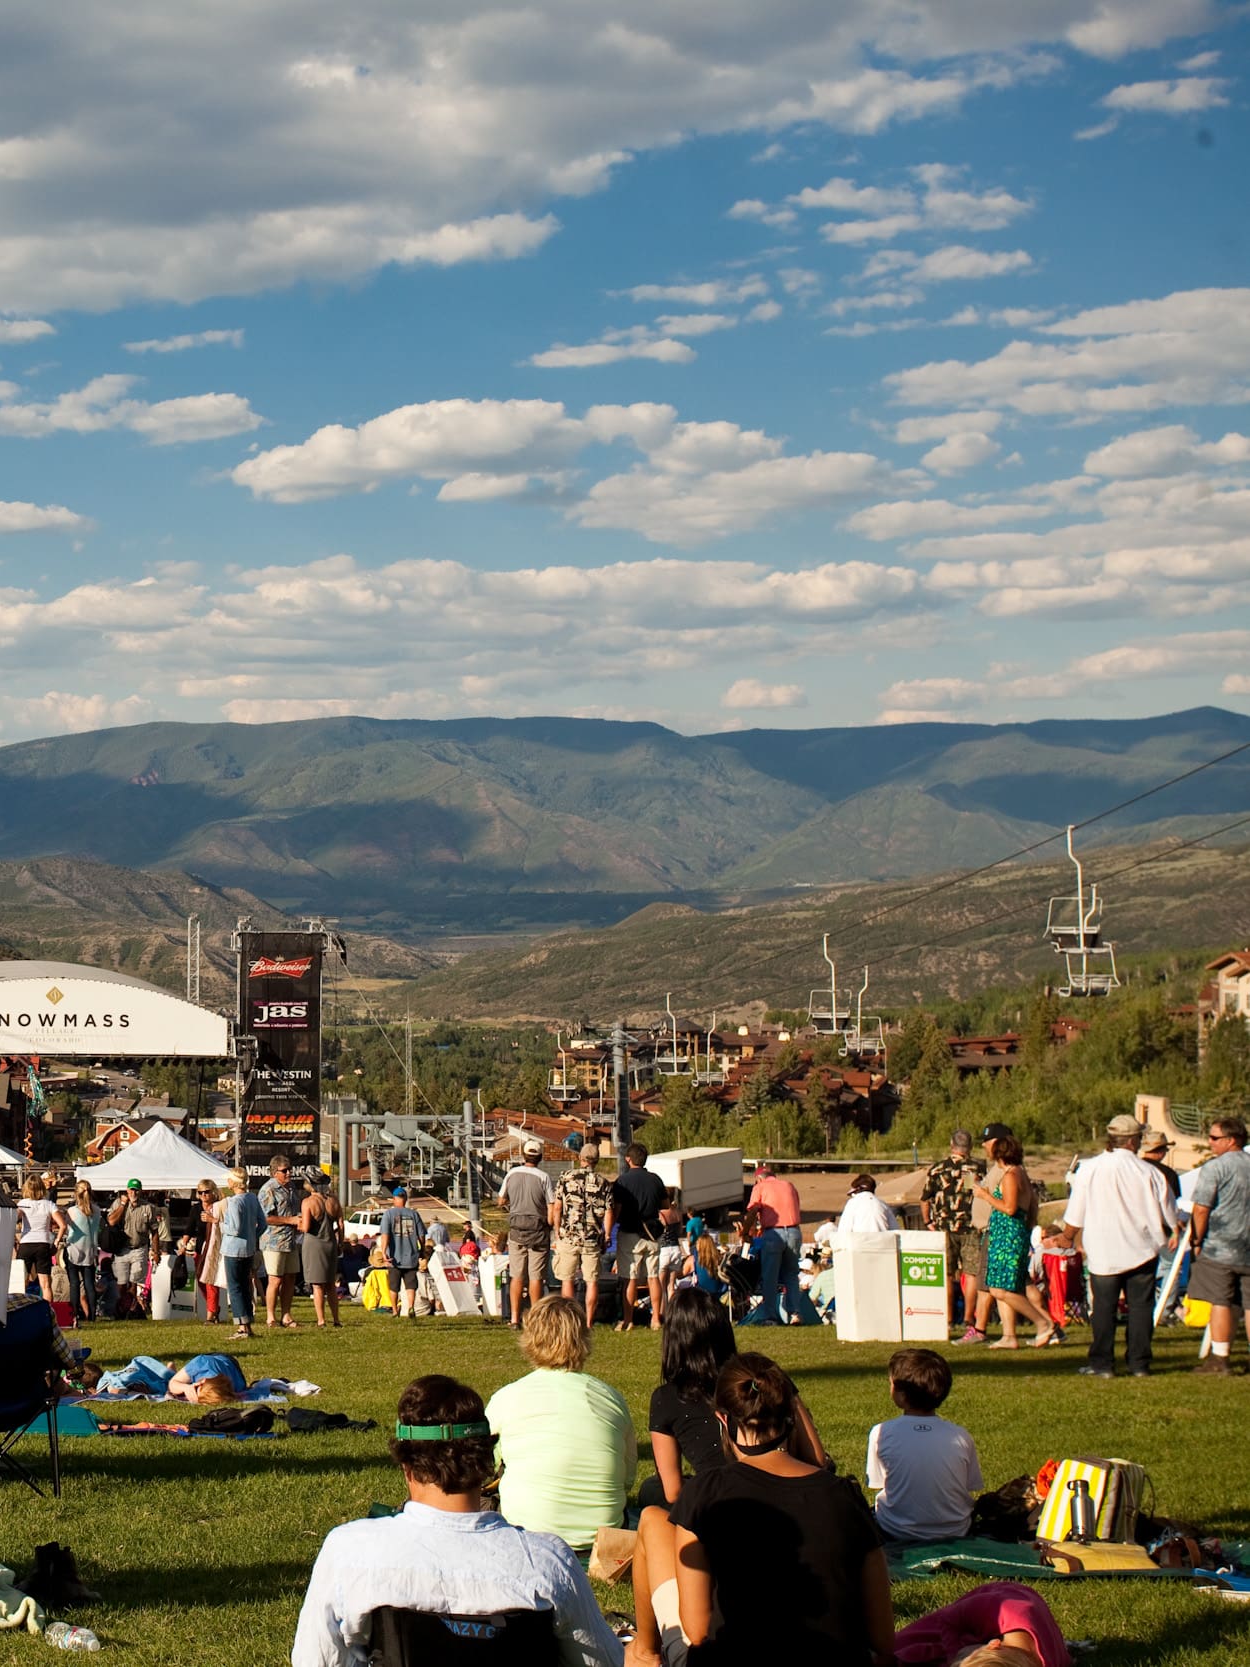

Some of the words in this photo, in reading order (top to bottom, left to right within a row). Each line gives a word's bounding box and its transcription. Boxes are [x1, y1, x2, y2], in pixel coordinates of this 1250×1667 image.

[248, 961, 311, 972] Budweiser
[253, 1005, 307, 1023] jas
[903, 1256, 942, 1265] COMPOST
